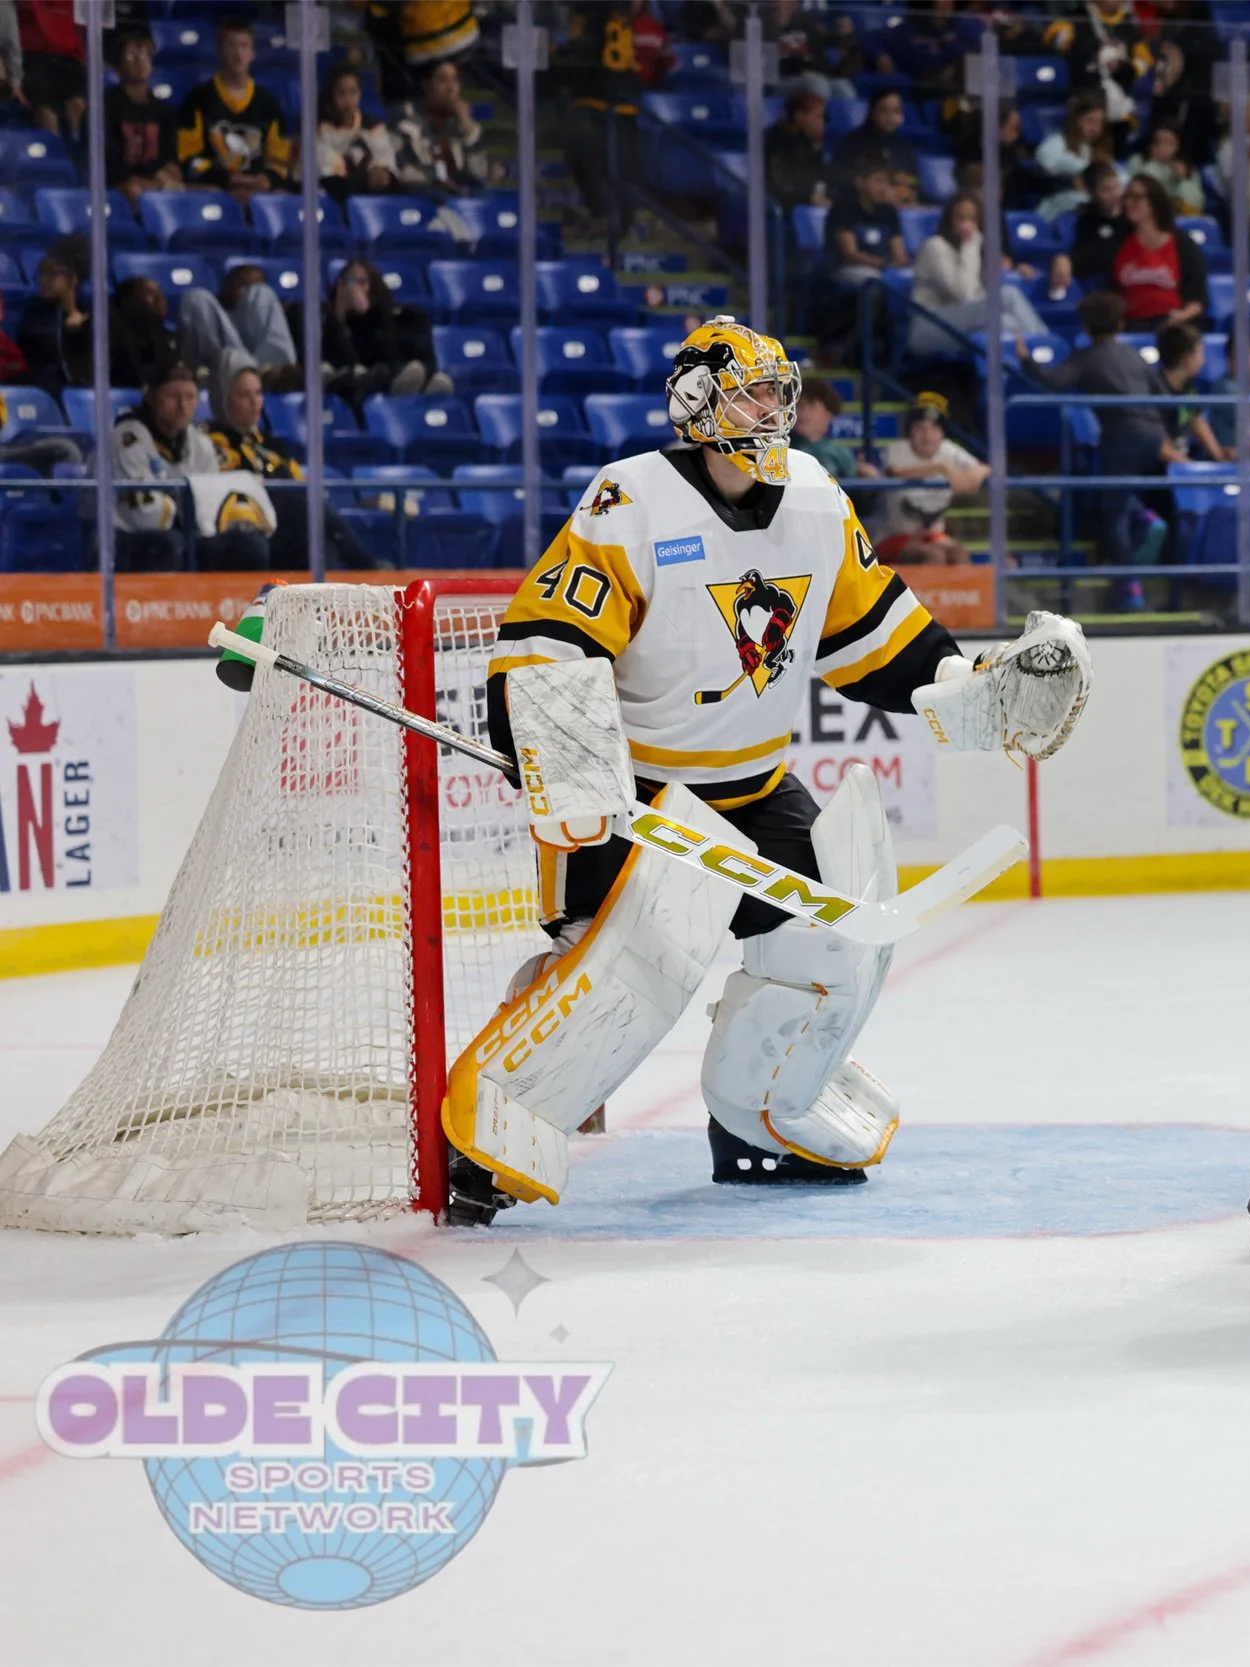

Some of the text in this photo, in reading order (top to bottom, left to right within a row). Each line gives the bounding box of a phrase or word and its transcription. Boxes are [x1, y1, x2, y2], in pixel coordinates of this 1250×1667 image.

[657, 542, 701, 558] Geisinger
[534, 557, 612, 620] 40
[791, 677, 899, 743] EX
[923, 708, 949, 744] CCM
[520, 747, 550, 816] CCM
[64, 760, 92, 888] LAGER
[629, 813, 859, 926] CCM
[476, 969, 561, 1066] CCM
[503, 971, 593, 1073] CCM
